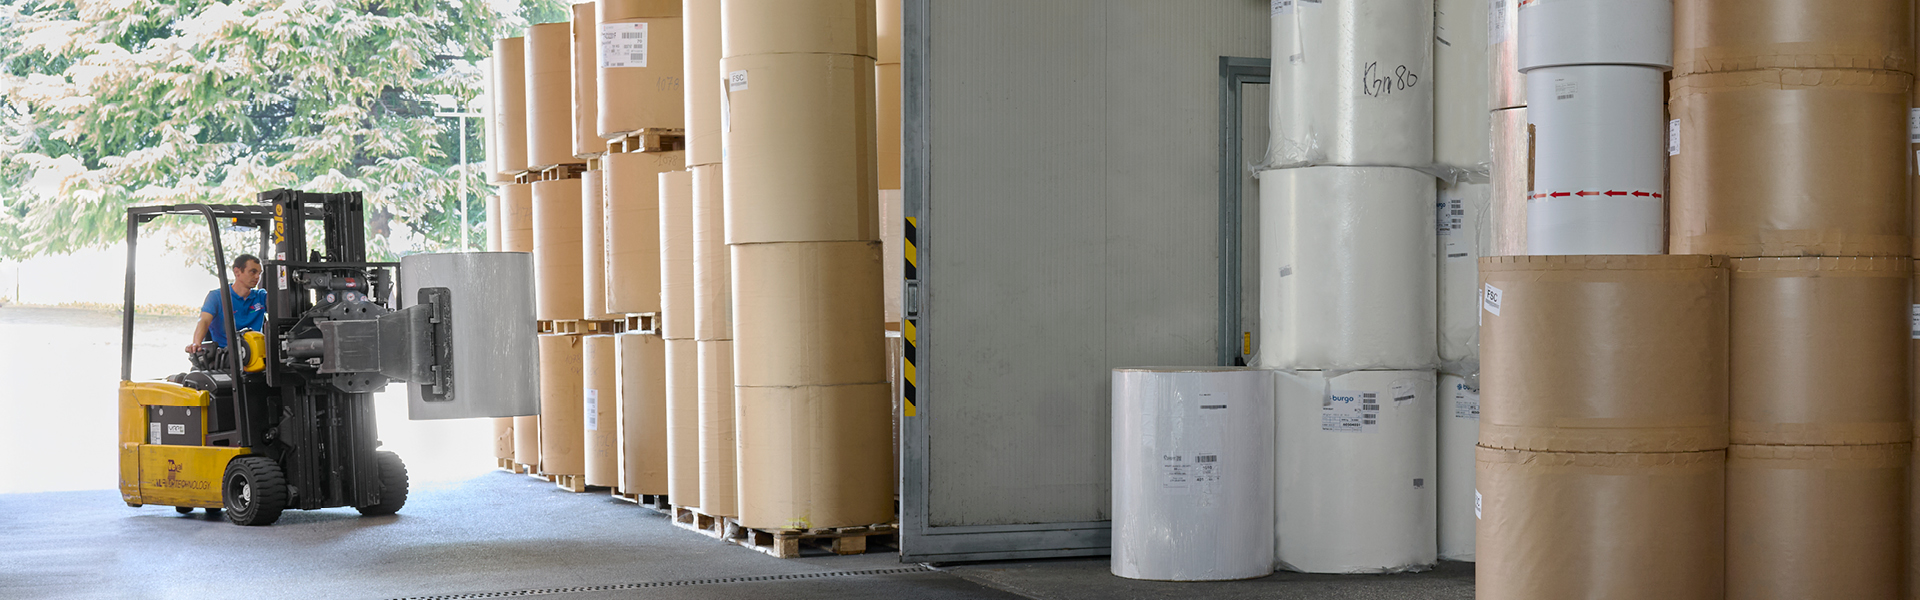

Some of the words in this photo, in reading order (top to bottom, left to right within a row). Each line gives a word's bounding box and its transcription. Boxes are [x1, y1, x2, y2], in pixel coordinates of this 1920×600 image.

[656, 76, 680, 92] 1078
[732, 73, 744, 82] FSC
[654, 154, 678, 167] 1078
[274, 203, 285, 245] Yale
[1486, 289, 1498, 302] FSC
[1332, 395, 1354, 403] burgo
